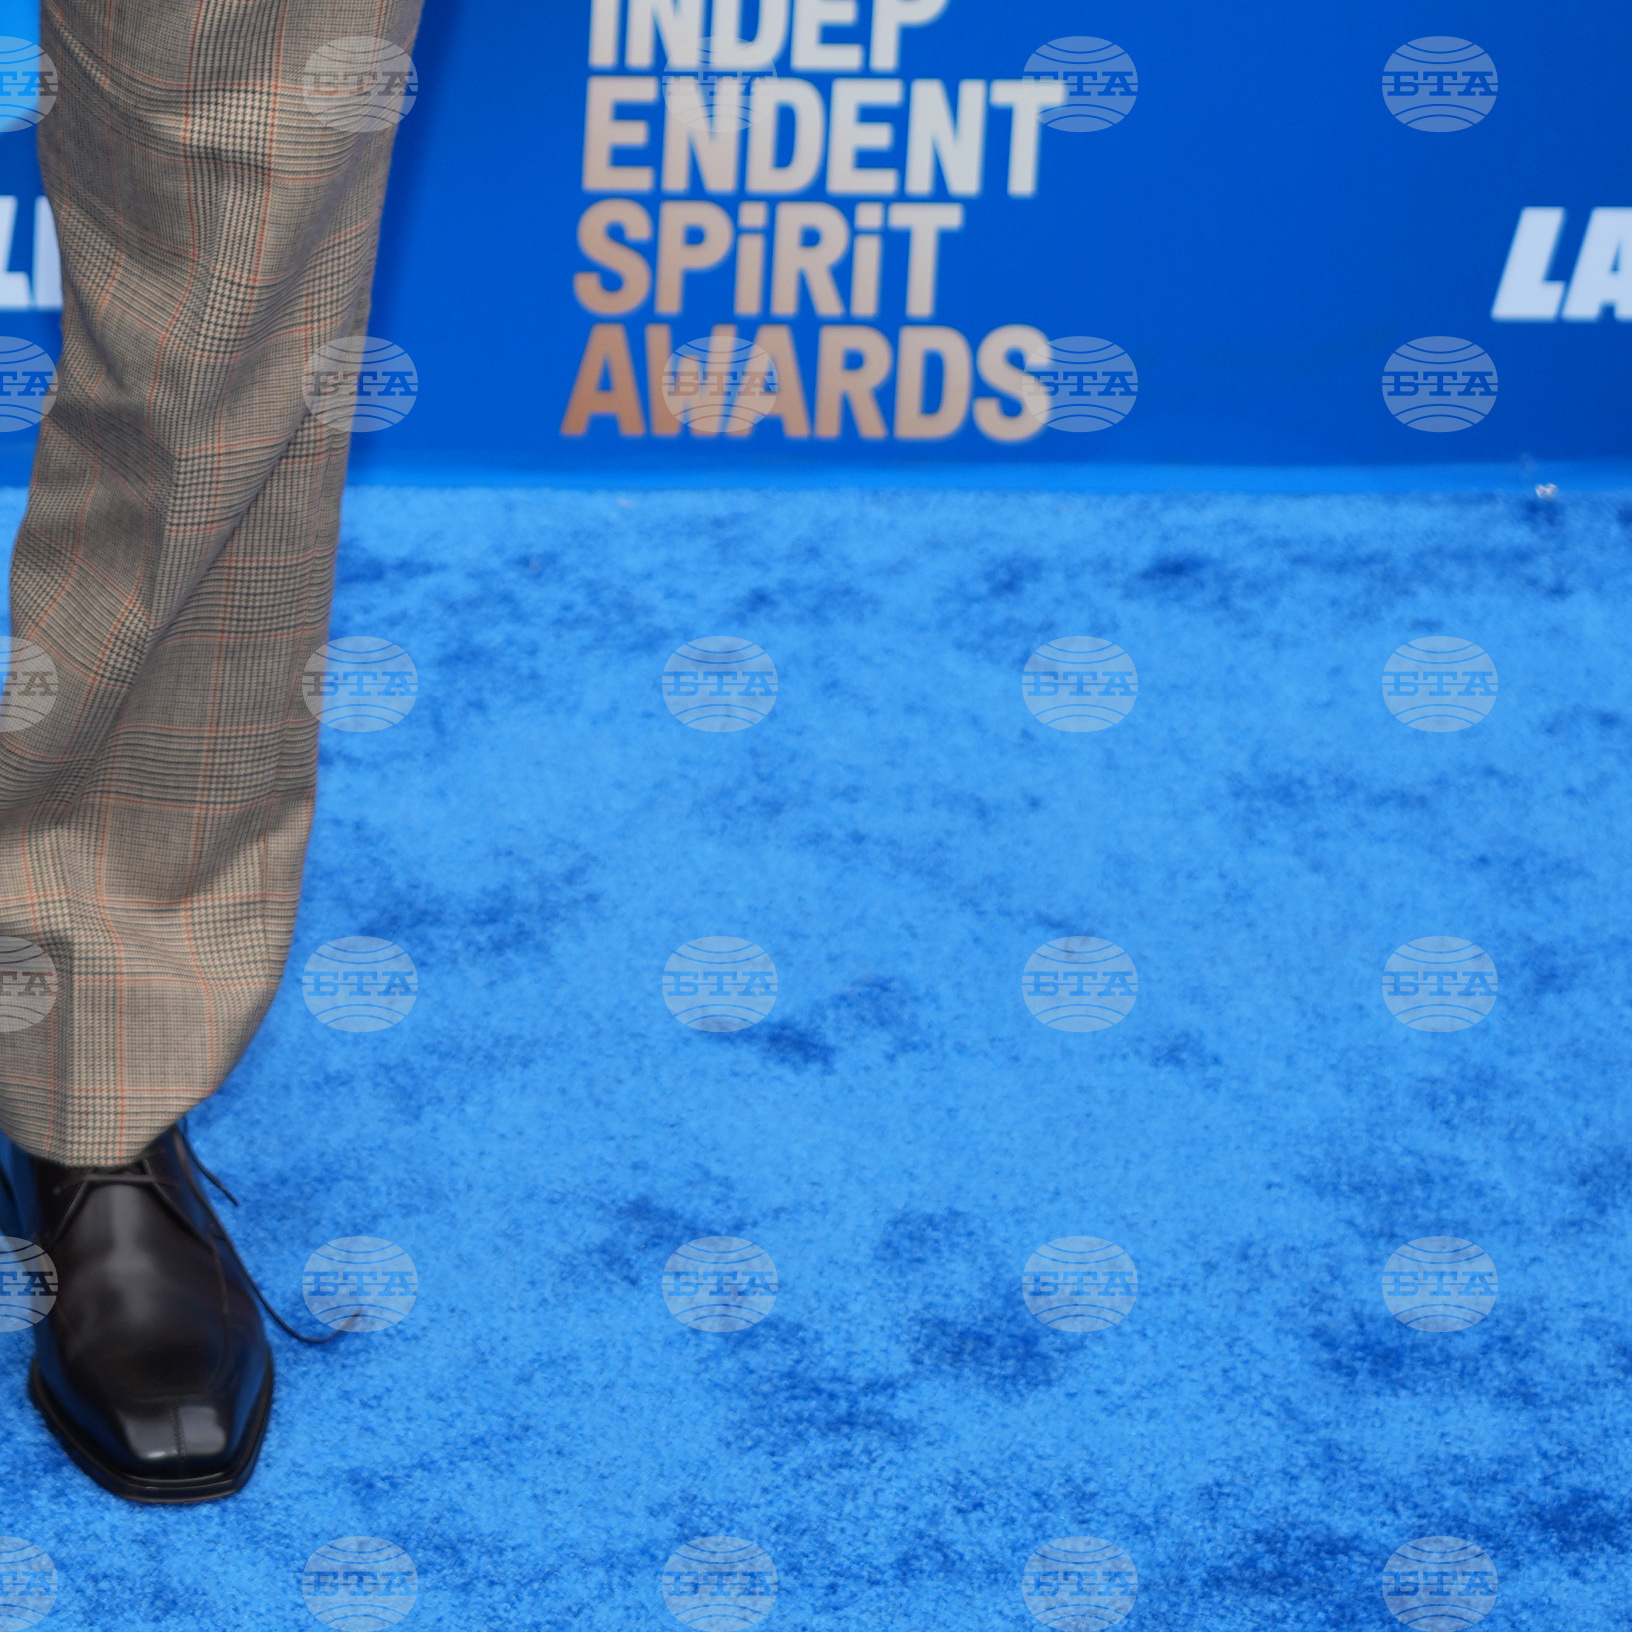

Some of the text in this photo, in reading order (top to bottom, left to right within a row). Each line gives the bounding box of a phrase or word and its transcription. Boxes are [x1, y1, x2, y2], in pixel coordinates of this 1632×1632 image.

[583, 76, 1067, 196] ENDENT
[575, 199, 962, 317] SPiRiT
[563, 324, 1052, 441] AWARDS
